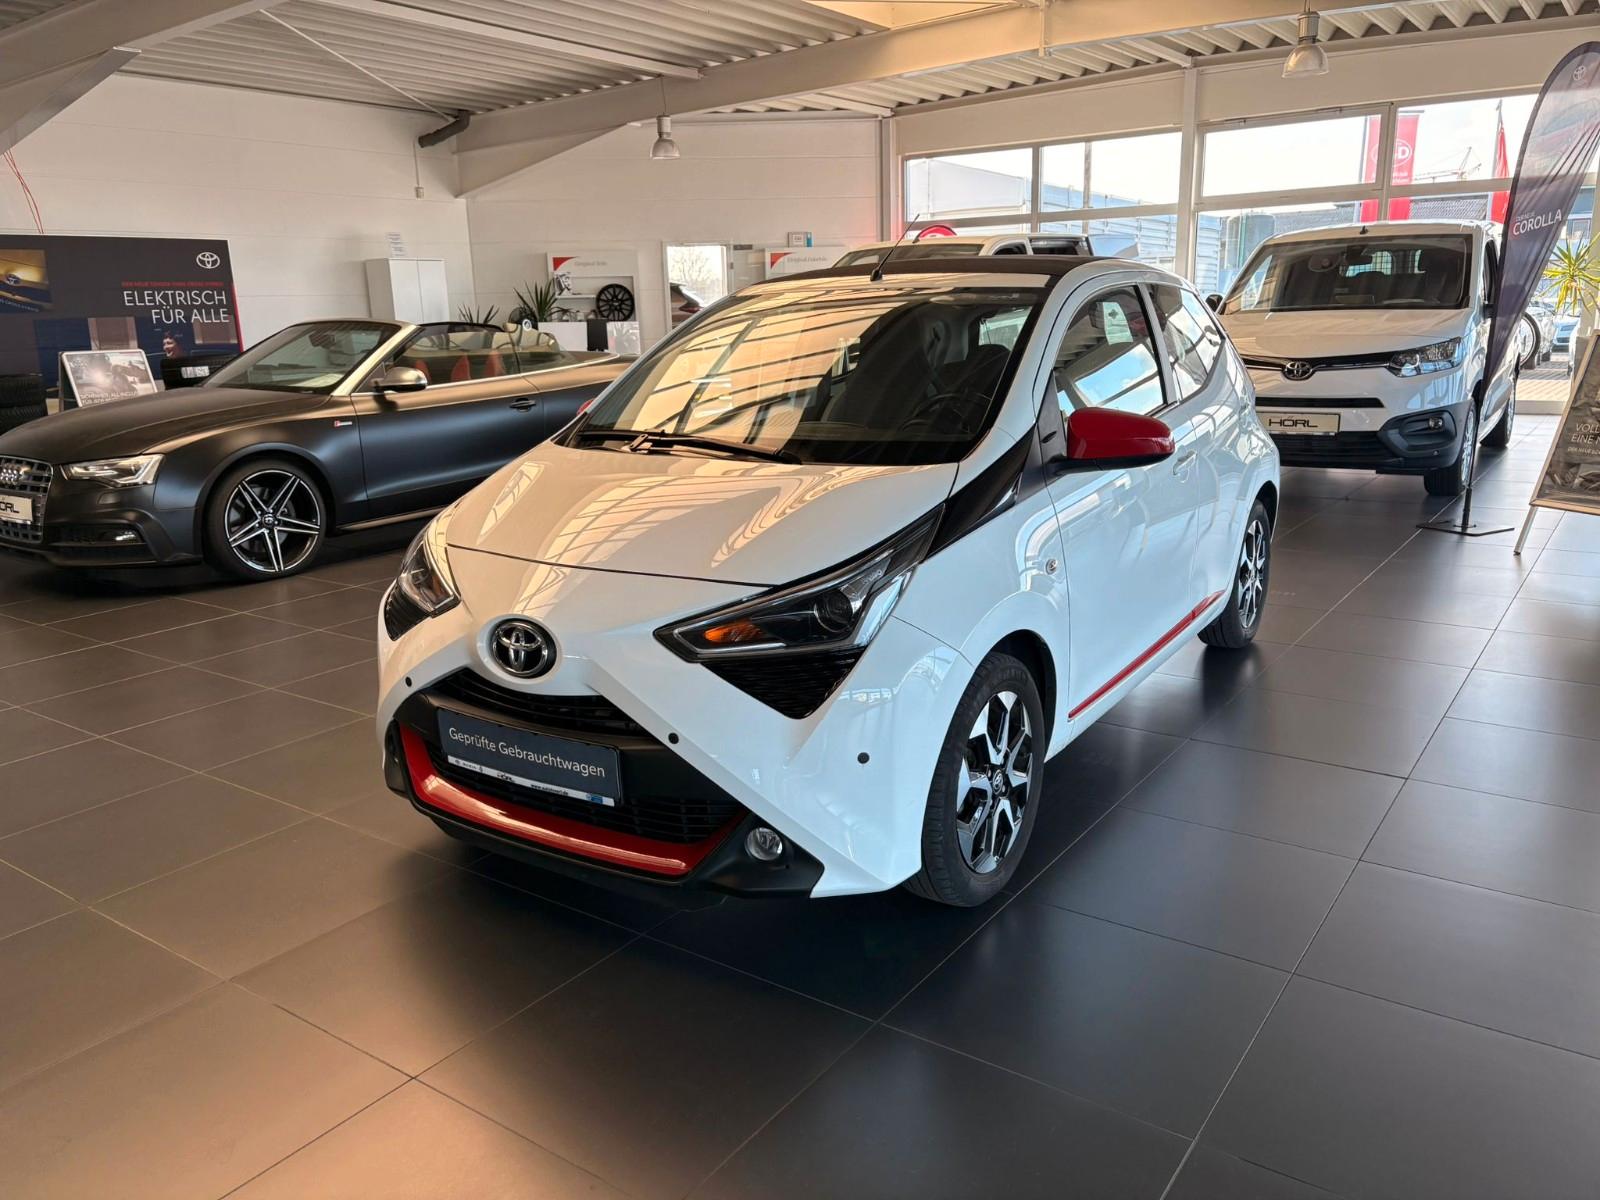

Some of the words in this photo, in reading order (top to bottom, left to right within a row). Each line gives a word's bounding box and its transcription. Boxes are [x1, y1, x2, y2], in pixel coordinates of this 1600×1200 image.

[1512, 208, 1562, 236] COROLLA
[122, 290, 227, 306] ELEKTRISCH
[151, 305, 187, 324] FÜR
[190, 308, 231, 324] ALLE
[1268, 415, 1319, 428] HÖRL
[1576, 423, 1600, 434] VOLL
[1570, 433, 1595, 445] EINE
[449, 727, 497, 752] Geprüfte
[498, 741, 606, 778] Gebrauchtwagen
